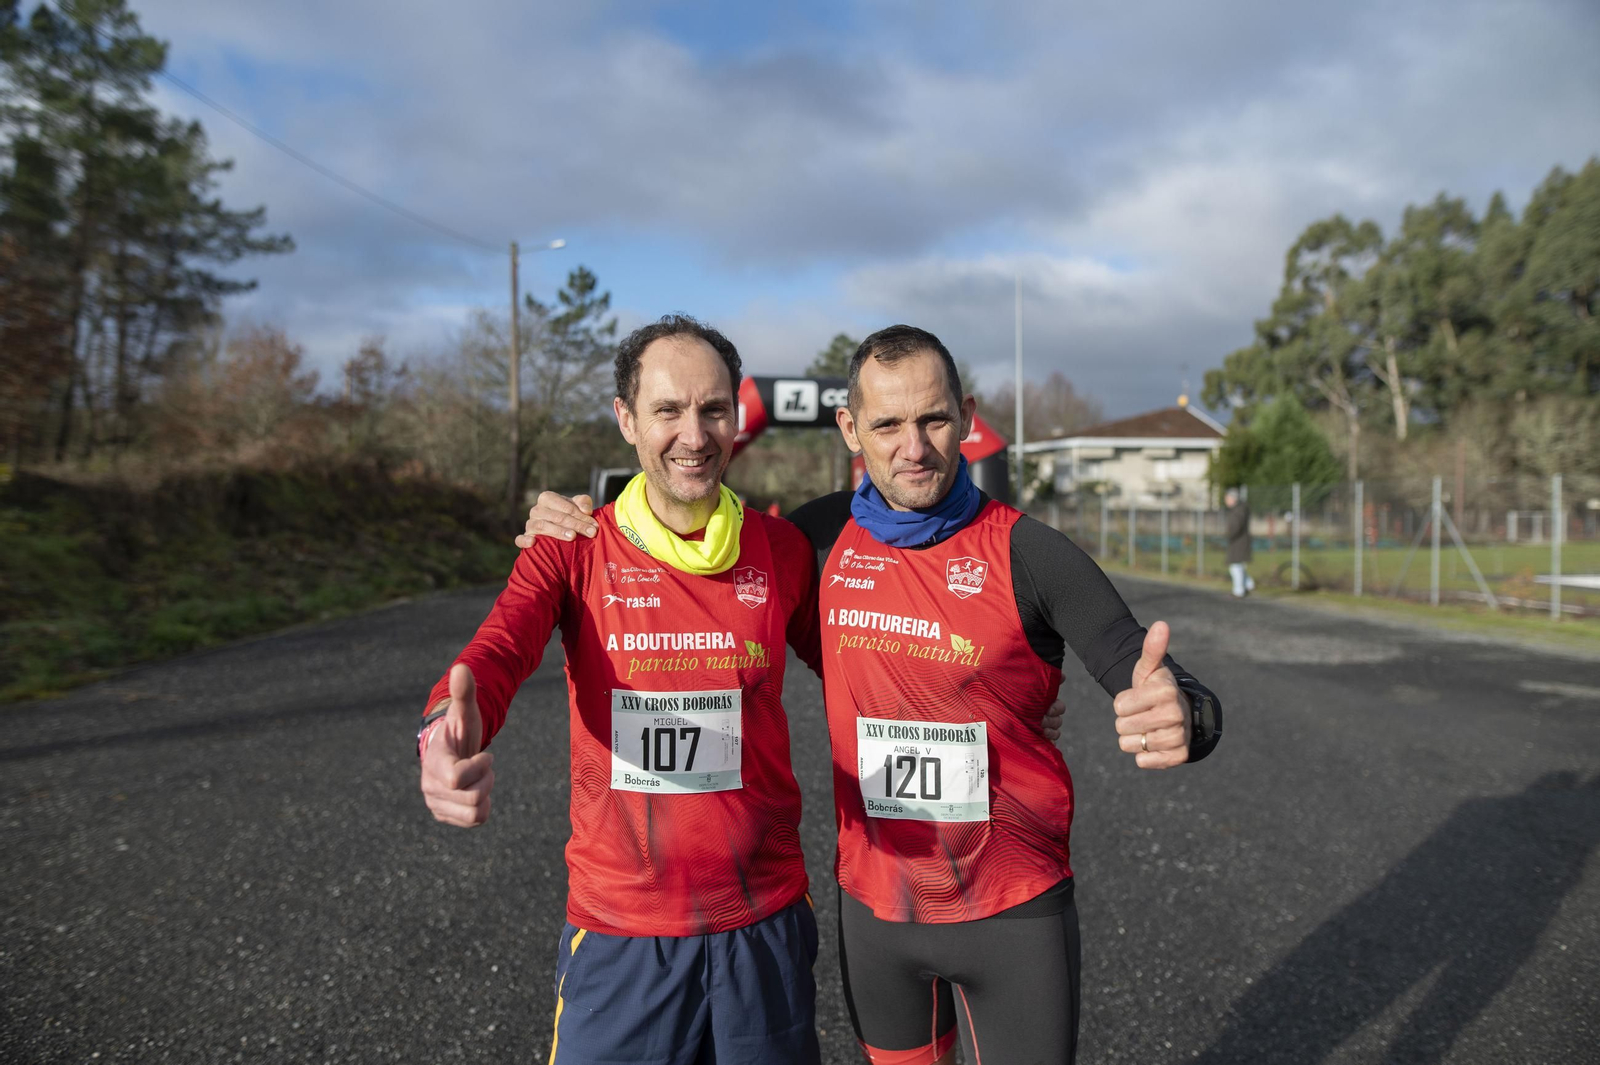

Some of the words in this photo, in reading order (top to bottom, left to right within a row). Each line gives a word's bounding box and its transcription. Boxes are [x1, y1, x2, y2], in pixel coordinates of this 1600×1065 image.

[844, 575, 875, 591] rasán
[626, 593, 661, 609] rasán
[827, 608, 836, 626] A
[838, 609, 942, 640] BOUTUREIRA
[606, 633, 619, 651] A
[623, 631, 736, 651] BOUTUREIRA
[836, 632, 901, 654] paraíso
[907, 643, 985, 667] natural
[626, 652, 699, 680] paraíso
[706, 647, 771, 669] natural
[621, 695, 642, 711] XXV
[644, 696, 679, 712] CROSS
[682, 693, 733, 711] BOBORÁS
[653, 717, 688, 726] MIGUEL
[865, 723, 885, 738] XXV
[887, 725, 920, 740] CROSS
[923, 726, 977, 743] BOBORÁS
[641, 727, 702, 772] 107
[893, 745, 921, 755] ANGEL
[925, 747, 932, 755] V
[883, 754, 942, 801] 120
